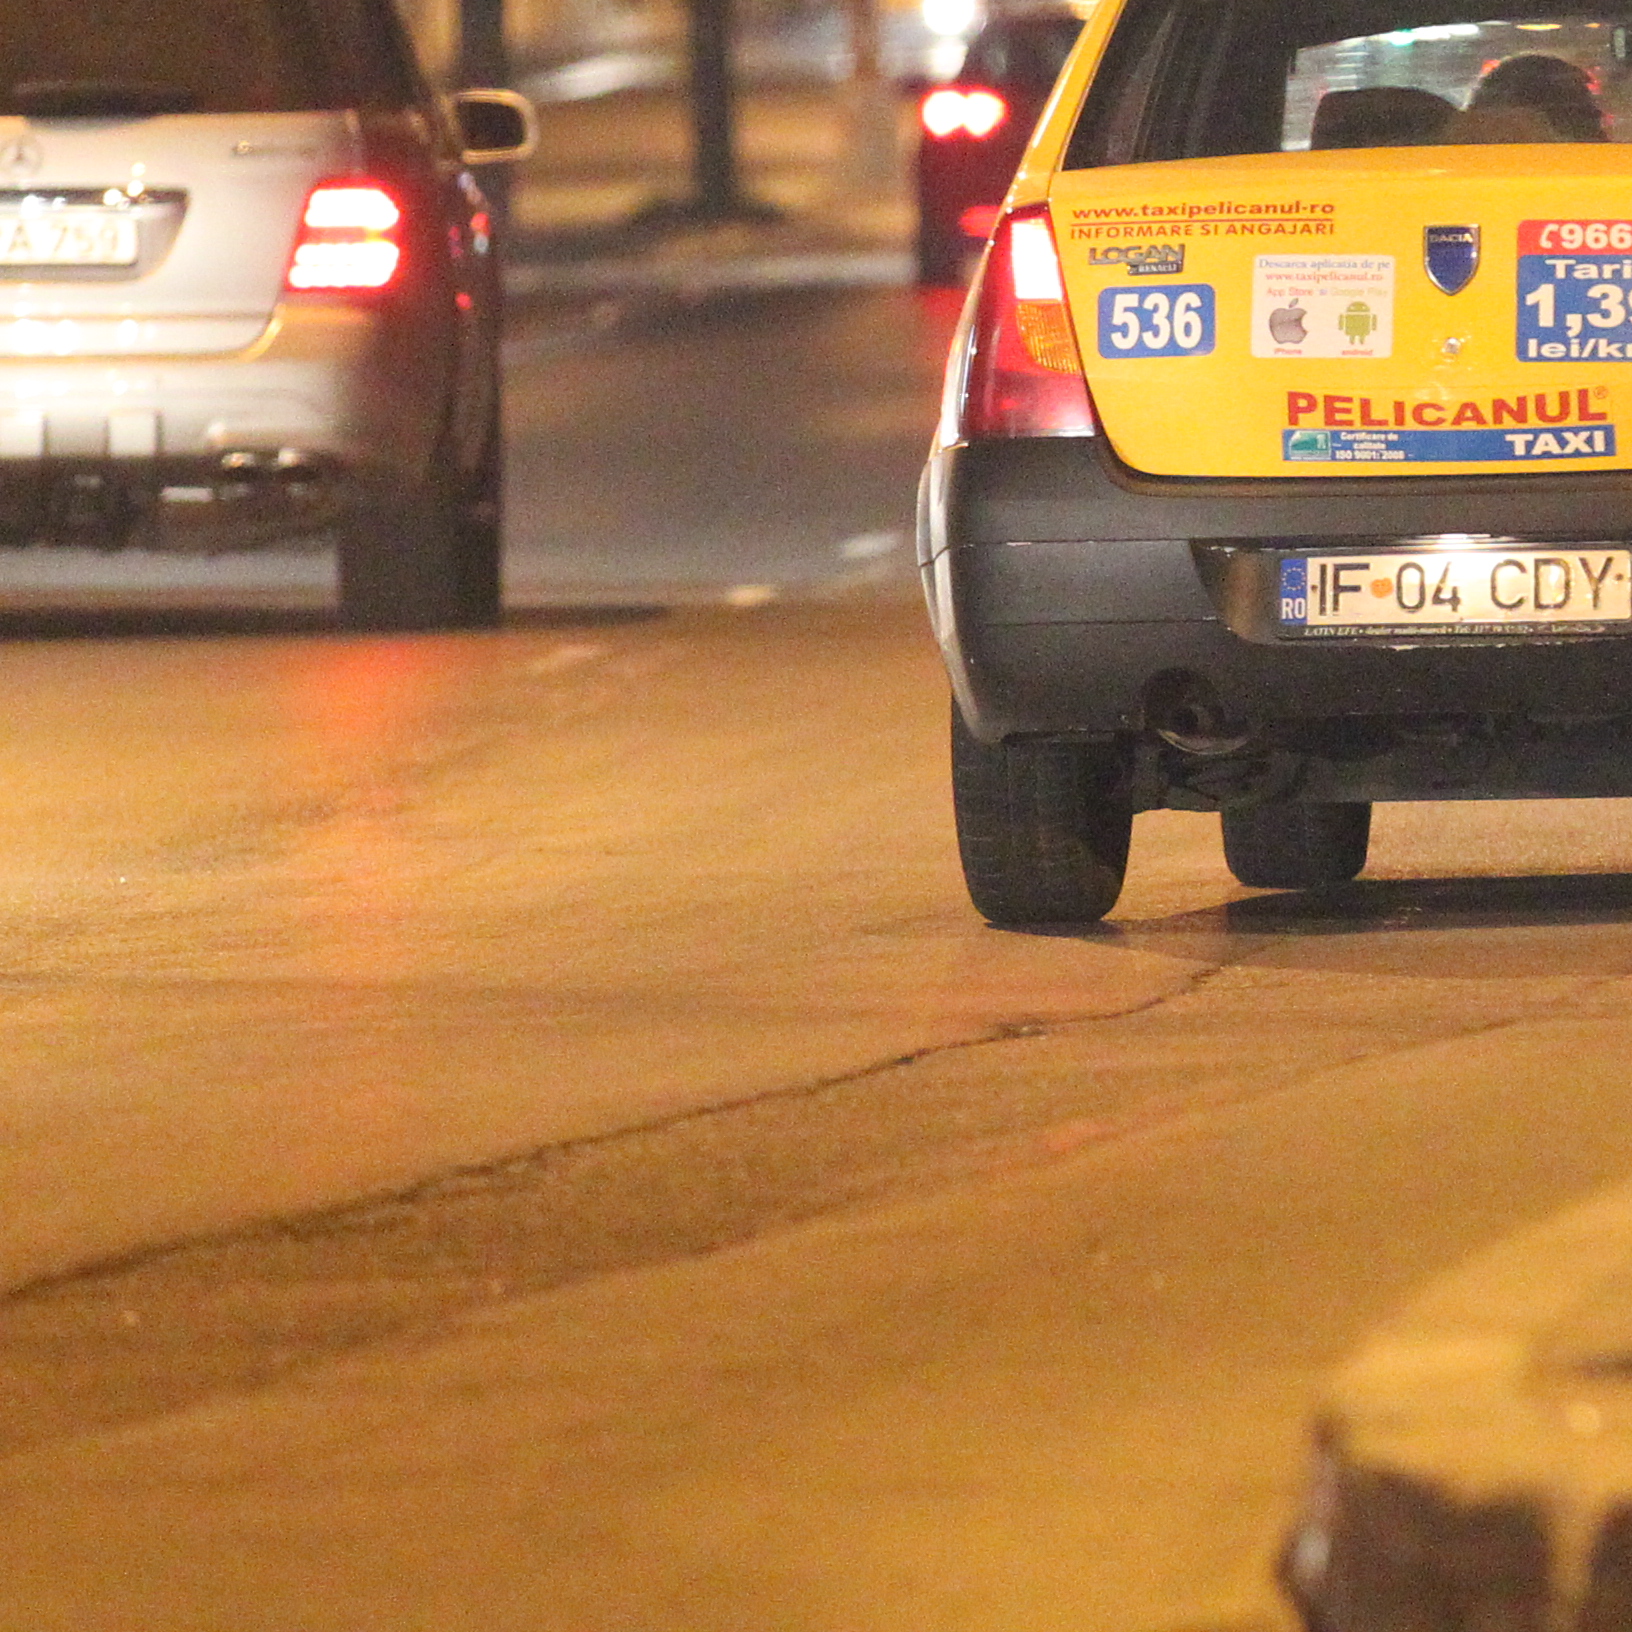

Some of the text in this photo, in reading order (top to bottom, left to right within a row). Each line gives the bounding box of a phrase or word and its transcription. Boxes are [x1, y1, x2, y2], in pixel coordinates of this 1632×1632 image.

[1069, 223, 1335, 240] INFORMARE SI ANGAJARI
[1088, 243, 1186, 266] LOGAN
[1110, 291, 1203, 350] 536
[1504, 430, 1607, 457] TAXI
[1318, 556, 1614, 617] IF 04 CDY
[1281, 597, 1306, 620] RO
